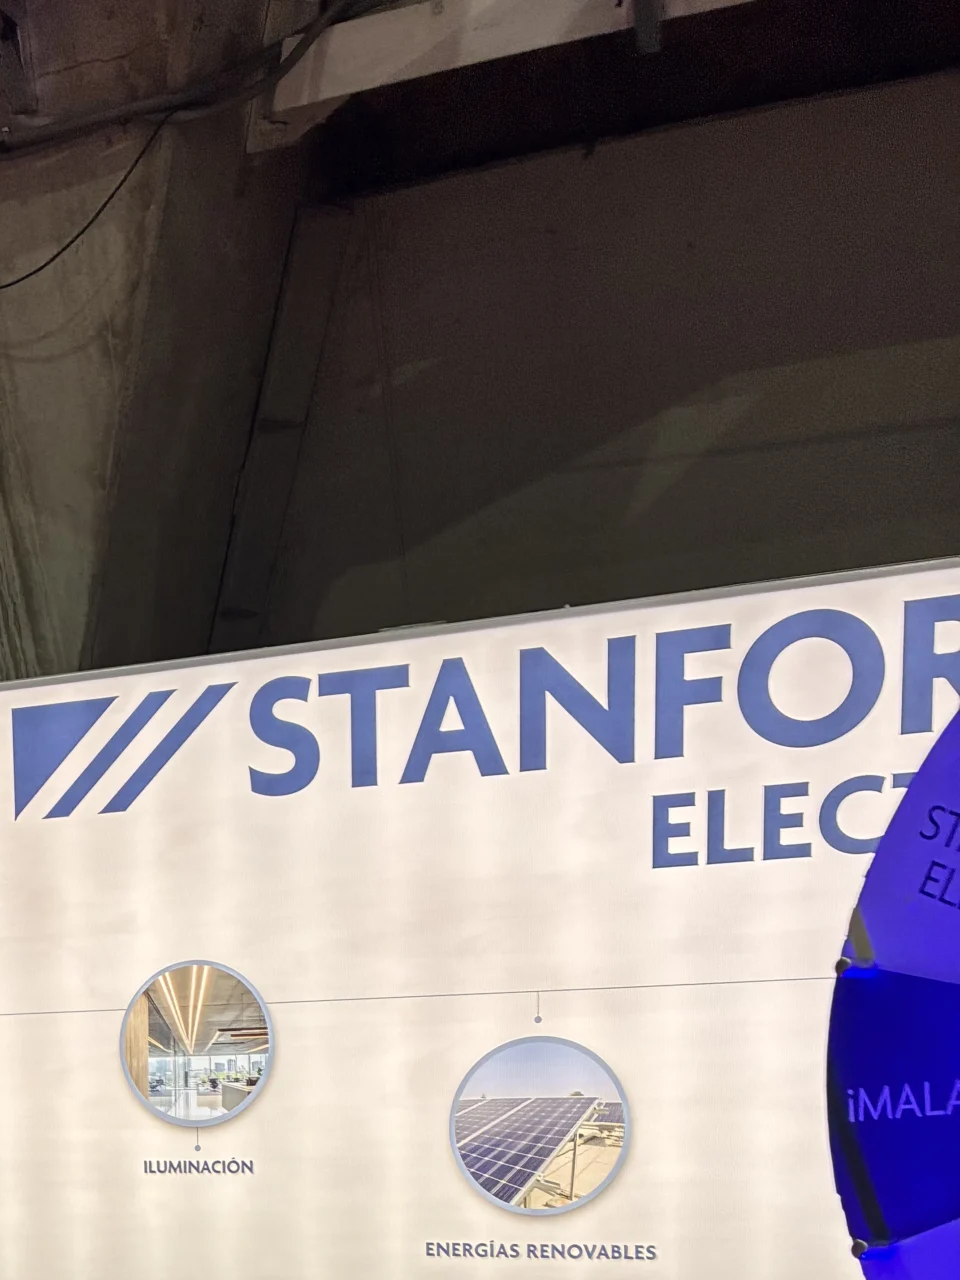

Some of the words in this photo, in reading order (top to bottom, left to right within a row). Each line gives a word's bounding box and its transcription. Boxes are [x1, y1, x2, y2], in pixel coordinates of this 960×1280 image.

[248, 594, 960, 797] STANFOR
[652, 771, 919, 868] ELEC
[919, 804, 960, 853] ST
[919, 860, 960, 911] EL
[143, 1157, 254, 1174] ILUMINACIÓN
[425, 1240, 520, 1258] ENERGÍAS
[526, 1243, 657, 1260] RENOVABLES
